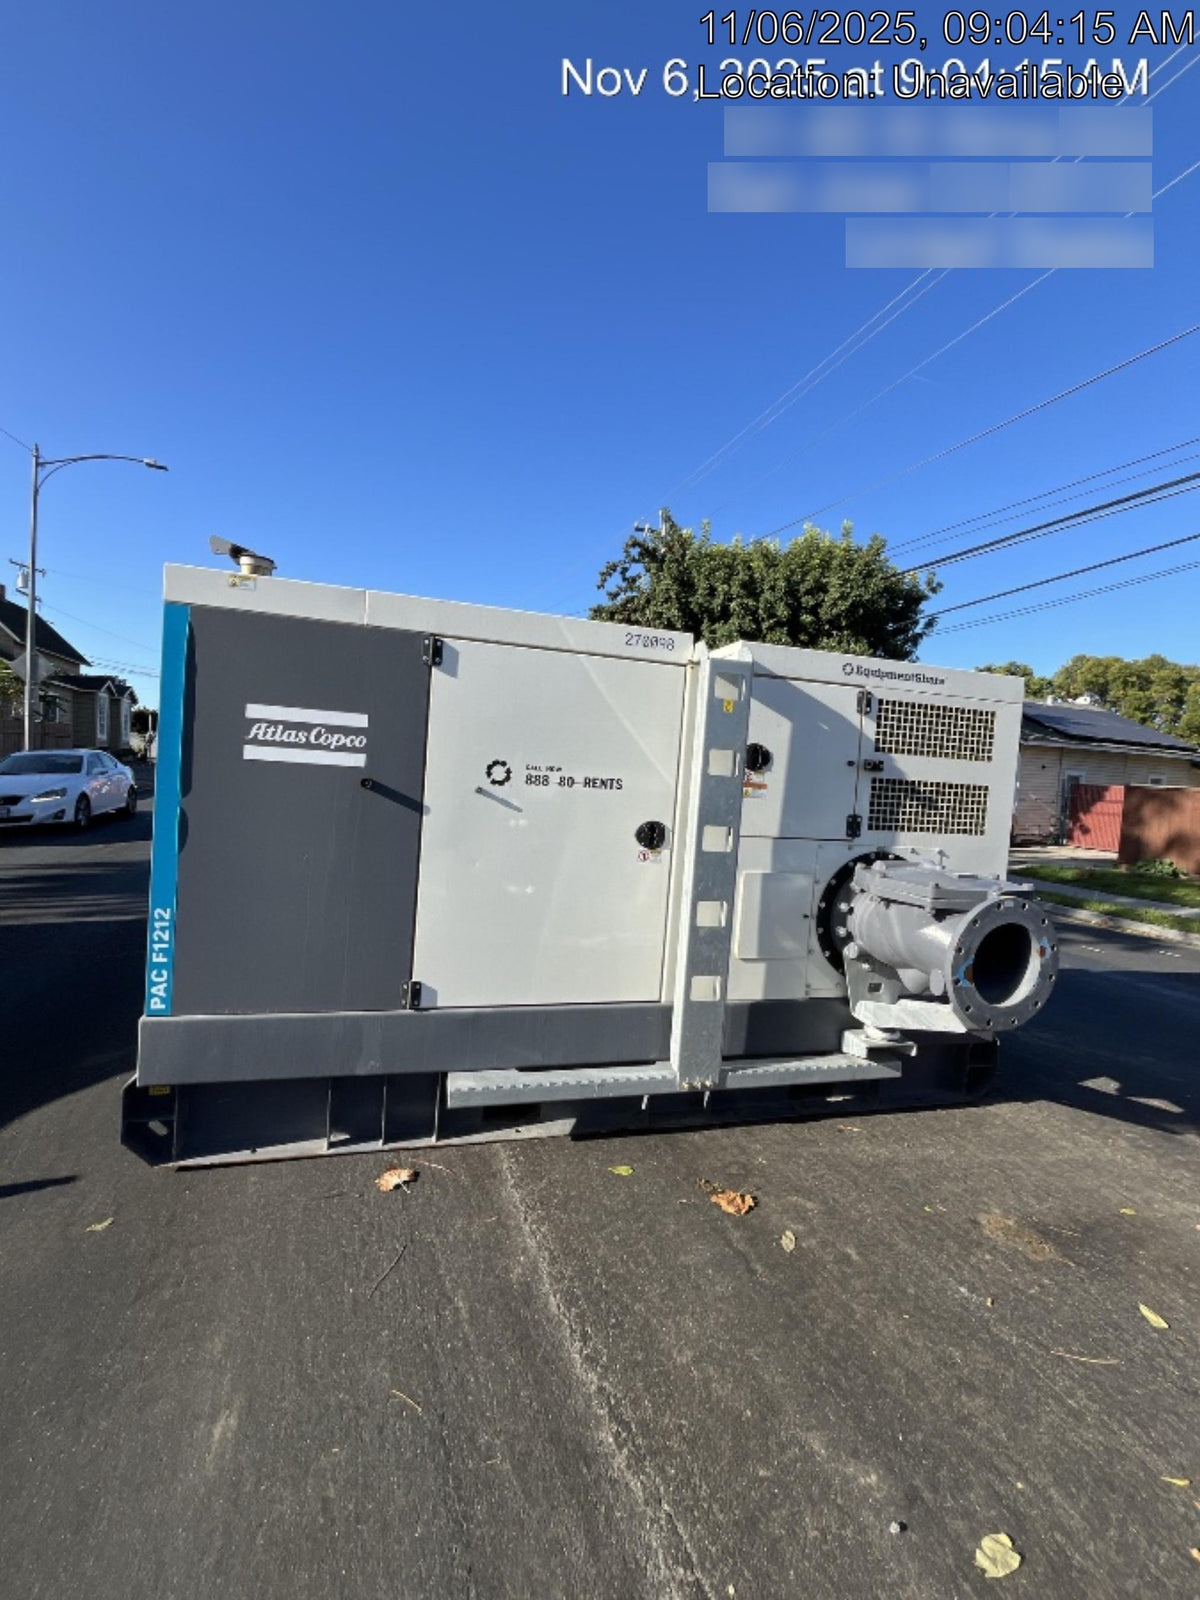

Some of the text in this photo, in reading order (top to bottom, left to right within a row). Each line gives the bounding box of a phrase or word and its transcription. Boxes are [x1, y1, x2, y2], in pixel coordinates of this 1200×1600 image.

[245, 721, 367, 750] Atlas Copco
[149, 907, 172, 1010] PAC F1212
